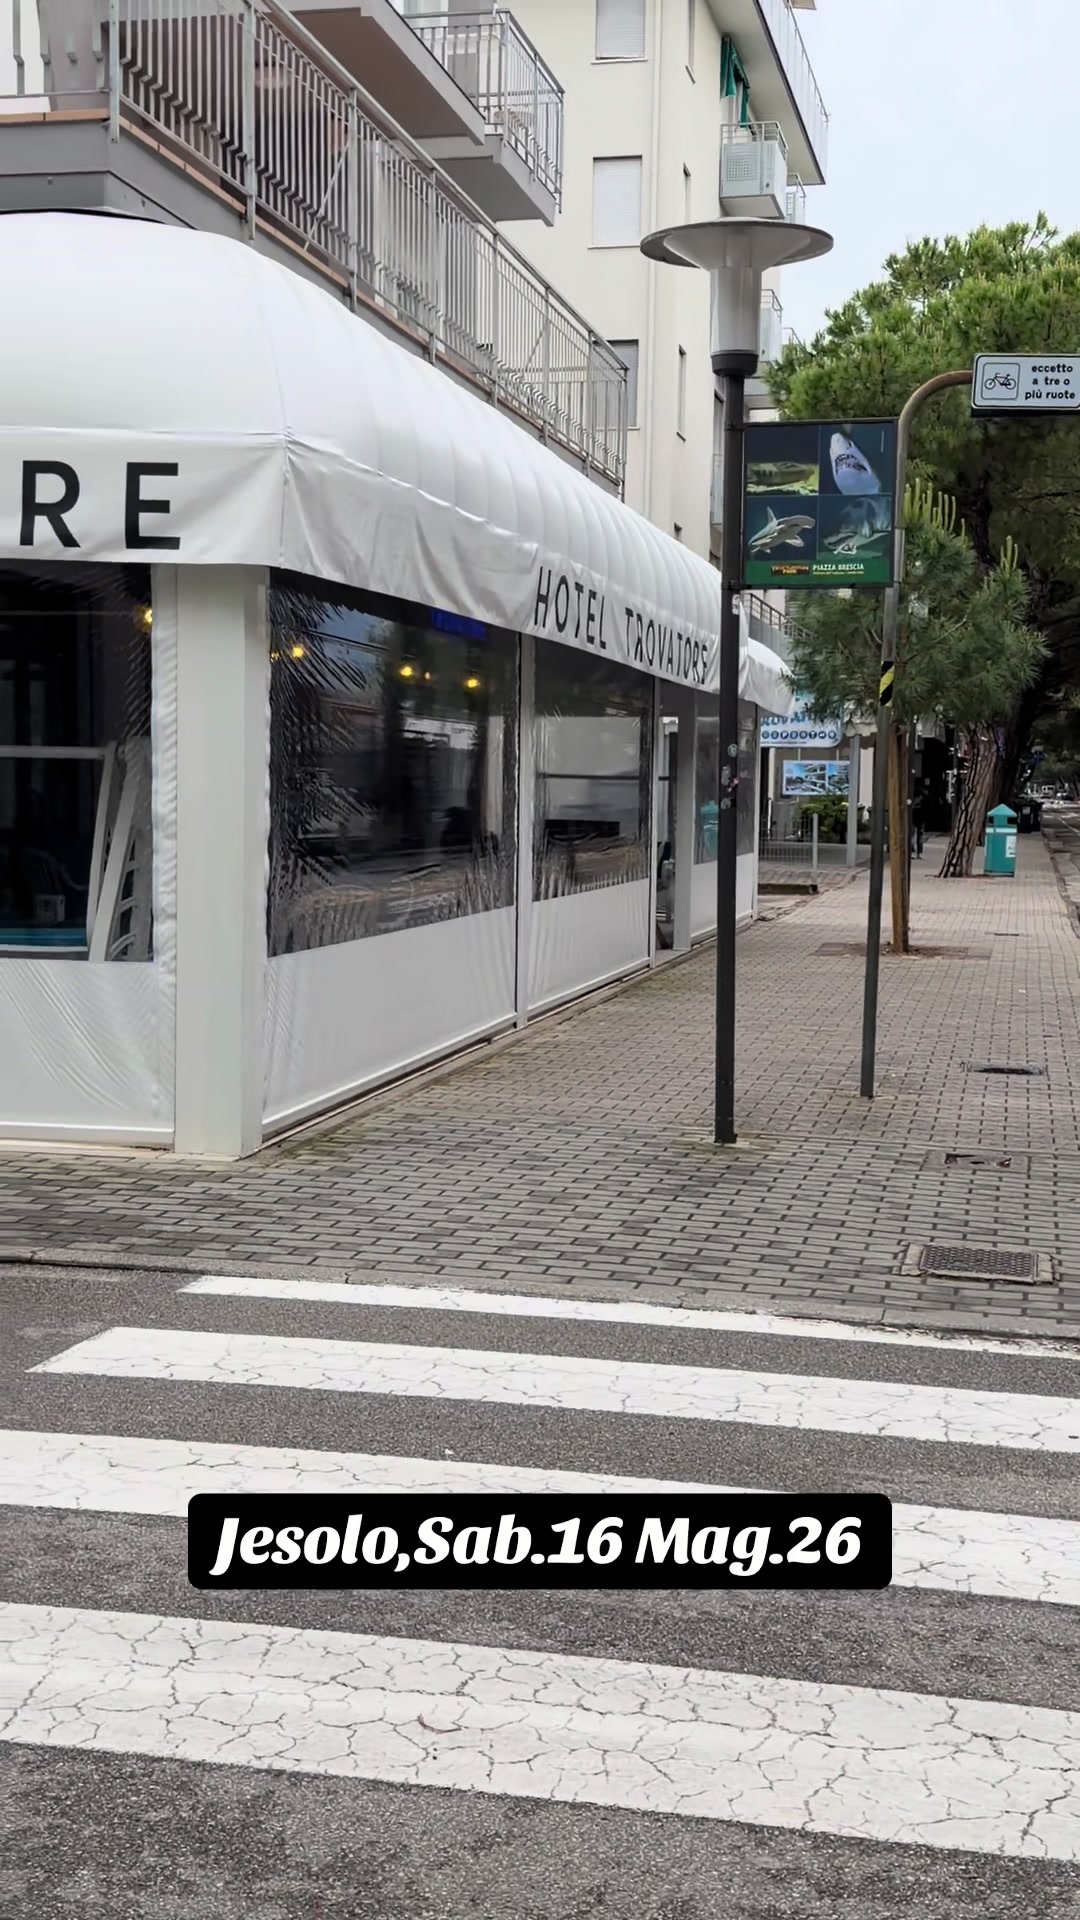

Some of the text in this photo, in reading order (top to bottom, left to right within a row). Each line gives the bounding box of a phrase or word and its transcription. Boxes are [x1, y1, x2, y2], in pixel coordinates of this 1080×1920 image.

[1031, 363, 1073, 373] eccetto
[1045, 376, 1060, 385] tre
[1063, 378, 1070, 386] o
[1025, 389, 1076, 401] più ruote
[838, 563, 865, 571] BRESCIA
[534, 566, 708, 684] HOTEL TROVATORE
